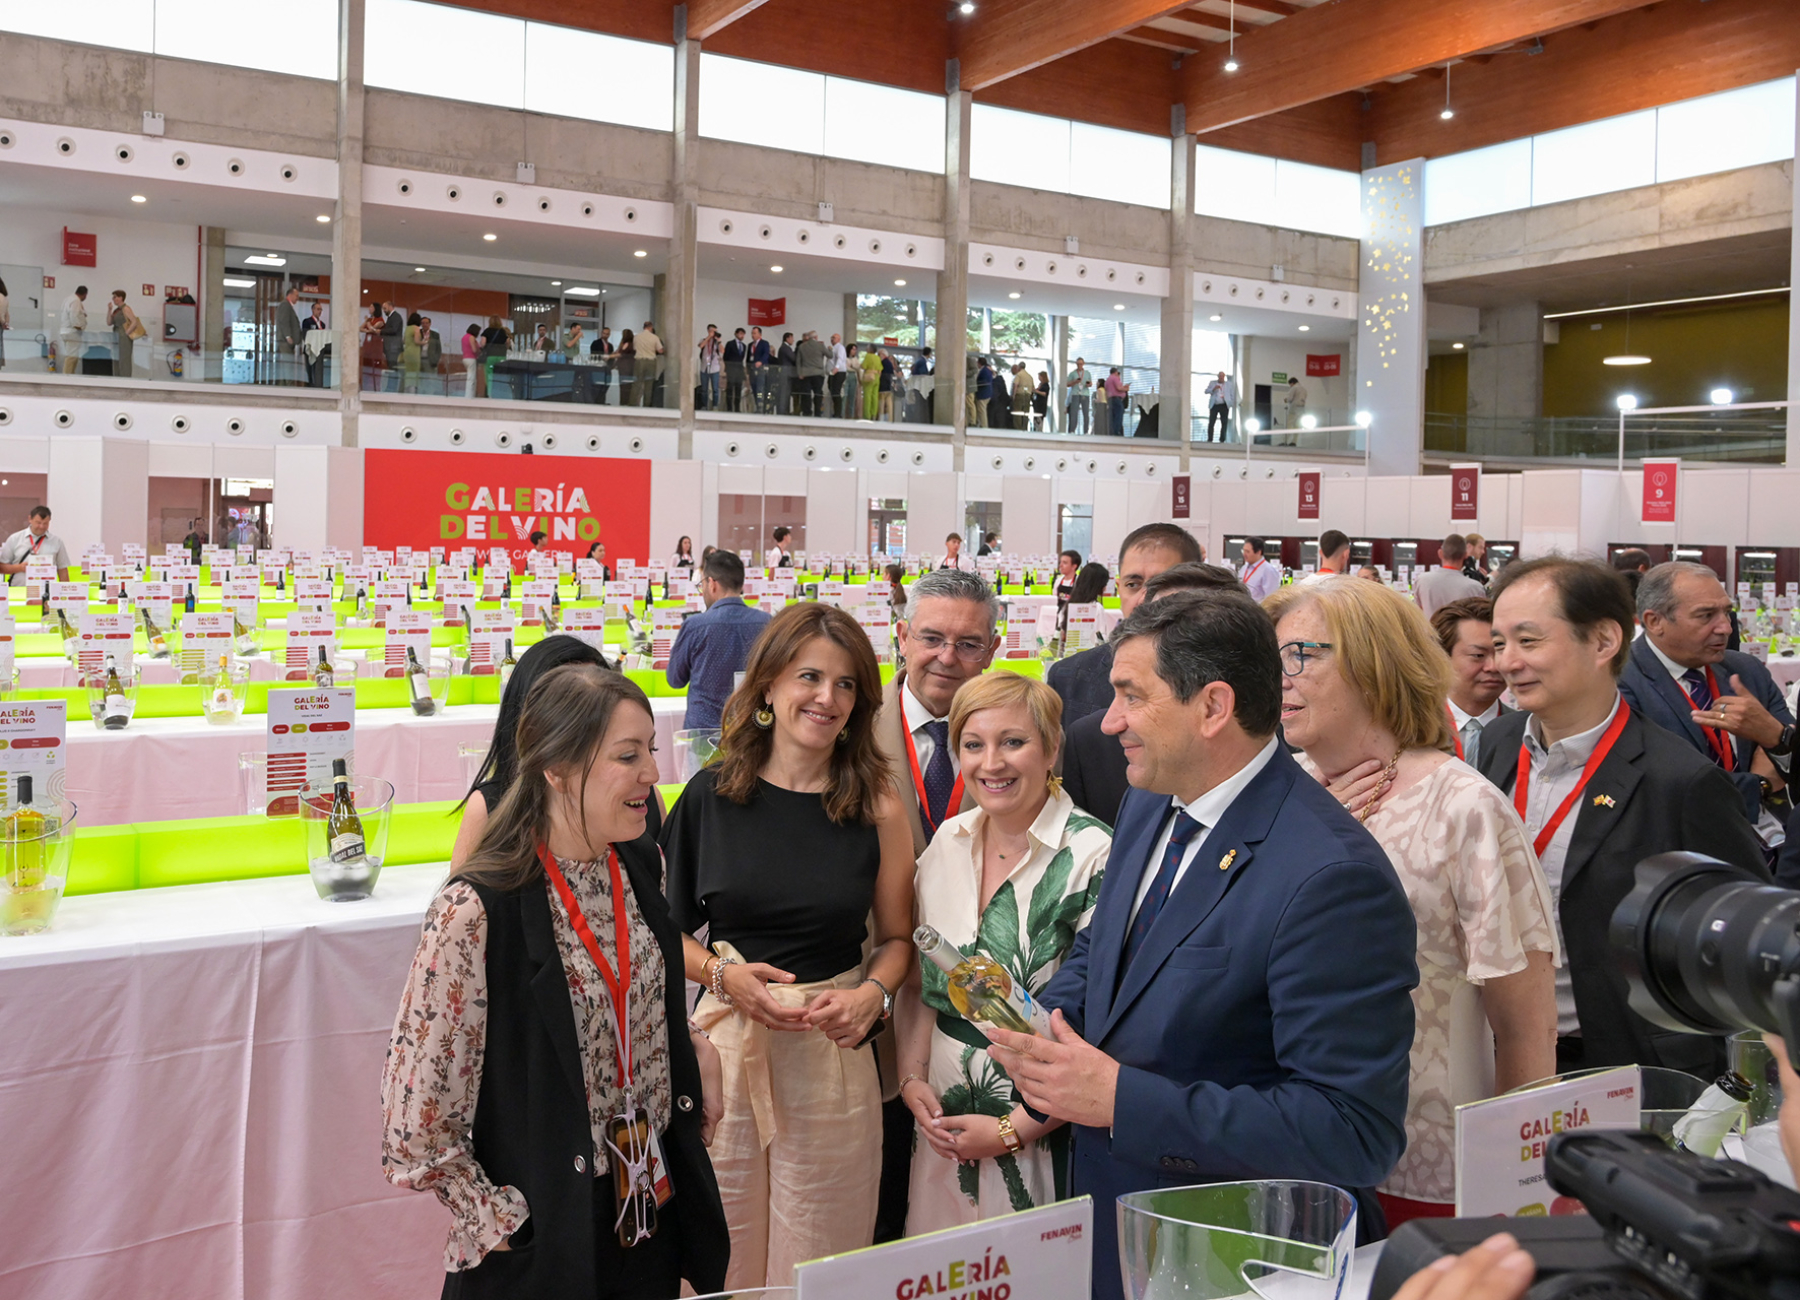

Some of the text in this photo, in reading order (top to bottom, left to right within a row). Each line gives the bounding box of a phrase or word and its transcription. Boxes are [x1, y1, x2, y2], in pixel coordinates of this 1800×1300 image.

[445, 482, 591, 513] GALERÍA
[1305, 494, 1313, 503] 13
[1461, 493, 1469, 502] 11
[1655, 488, 1664, 499] 9
[1178, 496, 1185, 504] 15
[440, 515, 601, 541] DEL VINO
[294, 694, 330, 704] GALERÍA
[0, 707, 36, 717] ALERÍA
[1520, 1101, 1590, 1141] GALERÍA
[1041, 1223, 1082, 1242] FENAVIN
[896, 1246, 1011, 1300] GALERÍA
